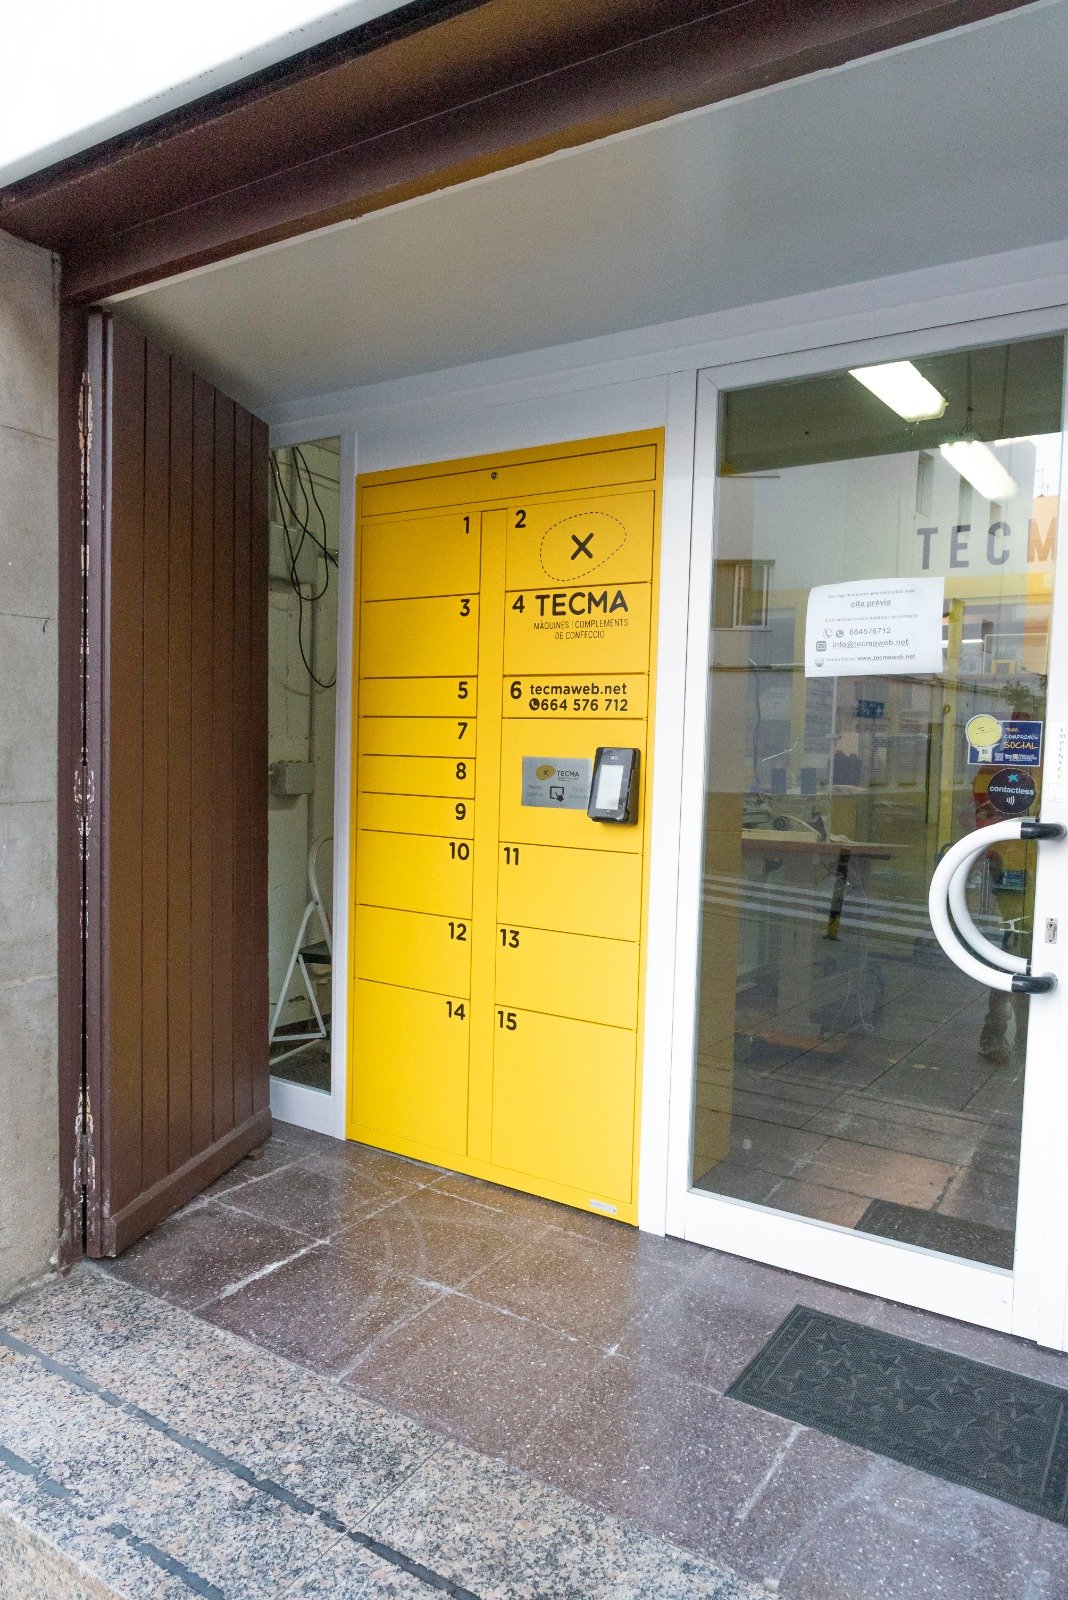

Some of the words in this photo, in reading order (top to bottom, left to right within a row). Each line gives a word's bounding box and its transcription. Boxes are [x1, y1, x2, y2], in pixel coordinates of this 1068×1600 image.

[463, 515, 471, 535] 1
[514, 509, 527, 529] 2
[459, 598, 471, 617] 3
[511, 594, 526, 614] 4
[534, 589, 629, 617] TECMA
[850, 600, 864, 608] cita
[575, 618, 629, 629] COMPLEMENTS
[554, 631, 564, 640] DE
[832, 638, 909, 649] info@tecmaweb.net
[457, 681, 469, 700] 5
[510, 680, 523, 700] 6
[529, 682, 628, 696] tecmaweb.net
[540, 698, 568, 712] 664
[572, 698, 599, 712] 576
[604, 698, 628, 712] 712
[457, 721, 468, 740] 7
[1003, 741, 1039, 750] SOCIAL
[455, 761, 467, 780] 8
[989, 785, 1035, 796] contactless
[455, 802, 467, 821] 9
[448, 842, 470, 861] 10
[503, 846, 520, 866] 11
[448, 922, 467, 942] 12
[499, 928, 520, 949] 13
[445, 1001, 466, 1021] 14
[497, 1010, 518, 1031] 15
